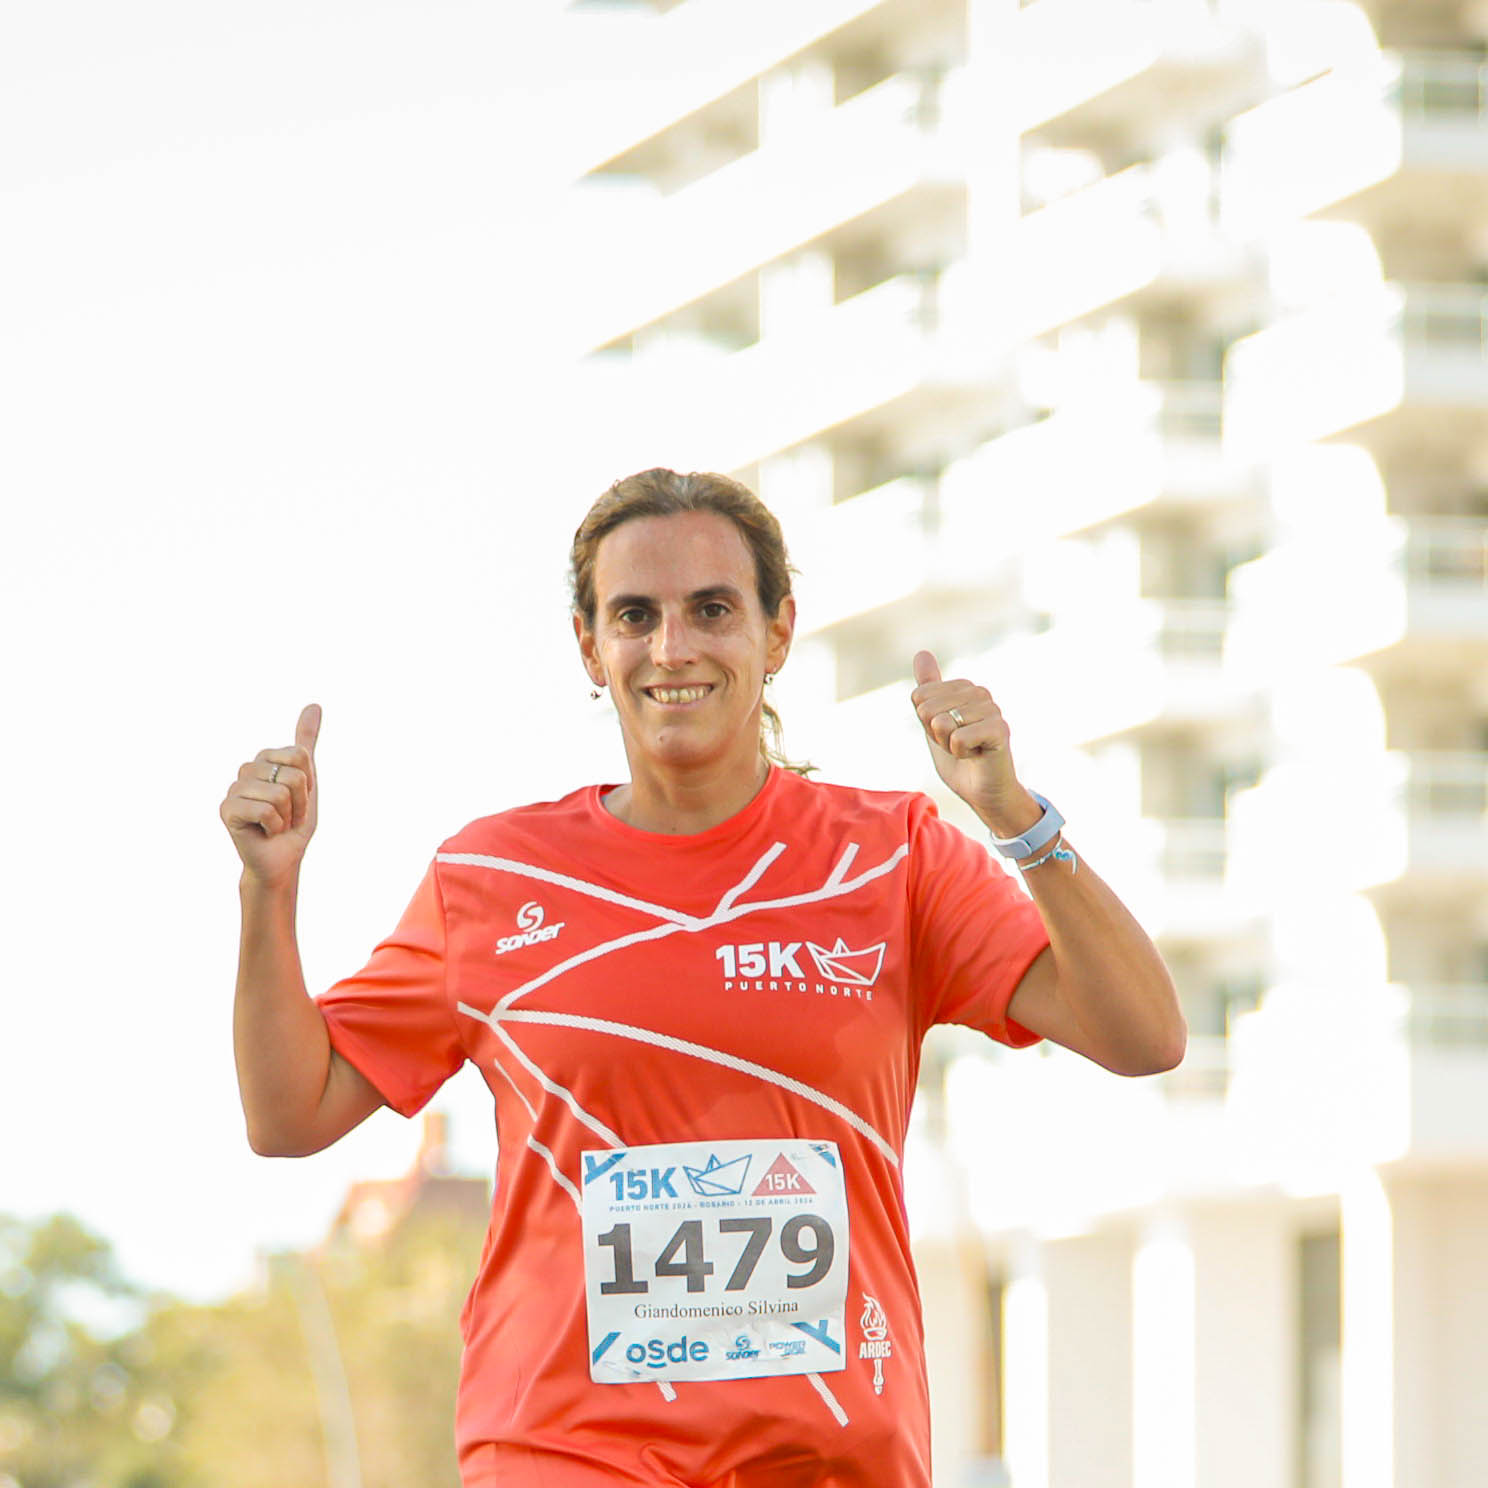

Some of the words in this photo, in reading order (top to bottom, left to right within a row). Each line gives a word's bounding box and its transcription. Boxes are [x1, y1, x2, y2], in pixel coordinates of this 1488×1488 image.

[715, 941, 805, 978] 15K
[725, 981, 807, 992] PUERTO
[815, 984, 873, 1000] NORTE
[610, 1167, 678, 1201] 15K
[765, 1172, 802, 1193] 15K
[598, 1214, 835, 1295] 1479
[634, 1303, 743, 1319] Giandomenico
[747, 1299, 799, 1315] Silvina
[626, 1335, 709, 1366] osde
